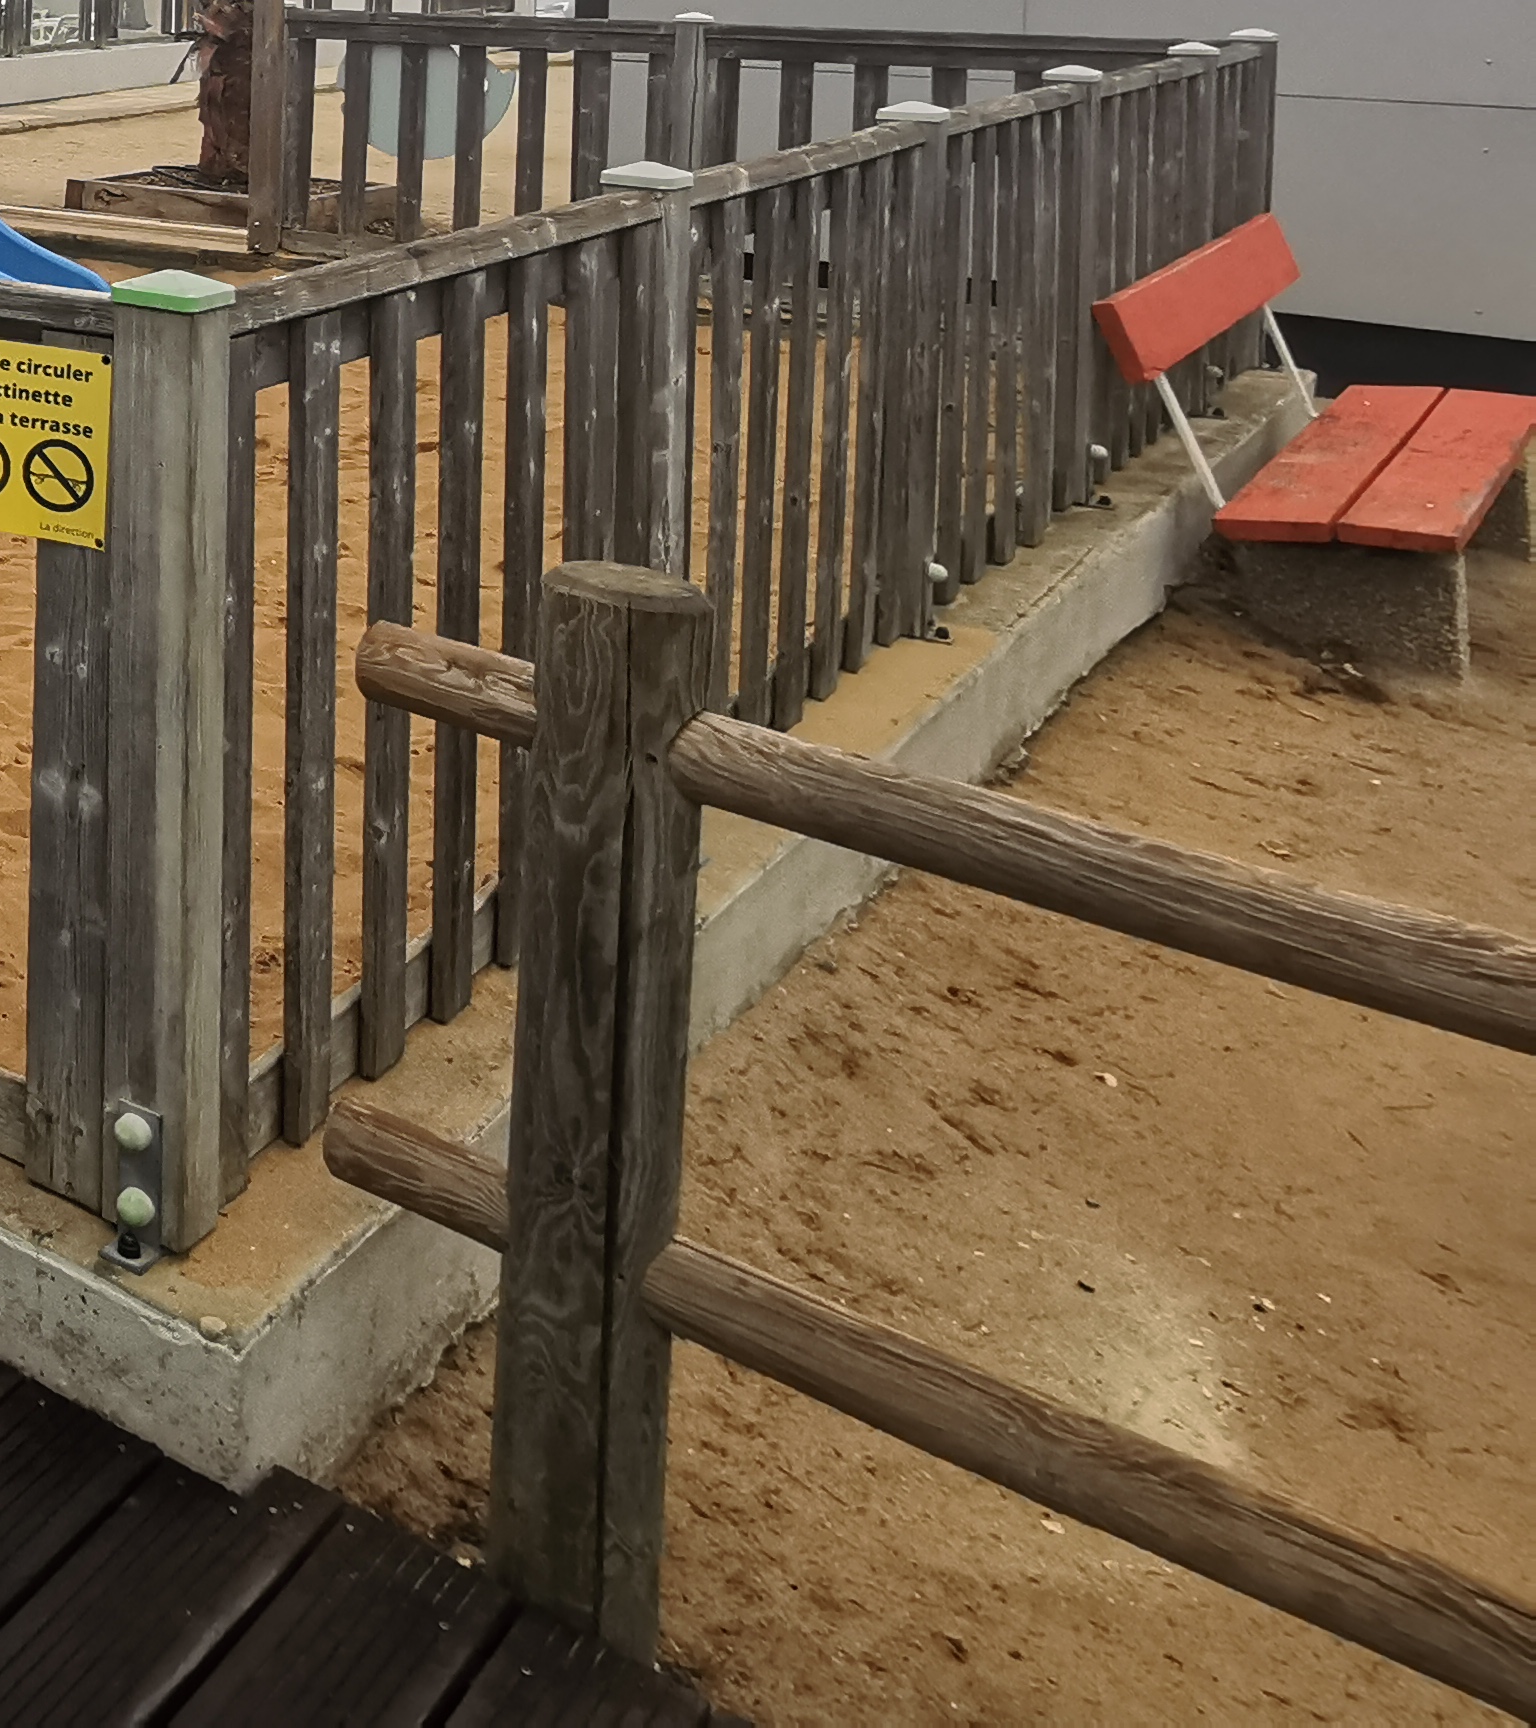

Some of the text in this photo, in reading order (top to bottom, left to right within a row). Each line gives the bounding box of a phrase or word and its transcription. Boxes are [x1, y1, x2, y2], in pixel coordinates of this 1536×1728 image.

[16, 358, 94, 383] circuler
[10, 412, 94, 439] terrasse
[52, 520, 95, 540] direction
